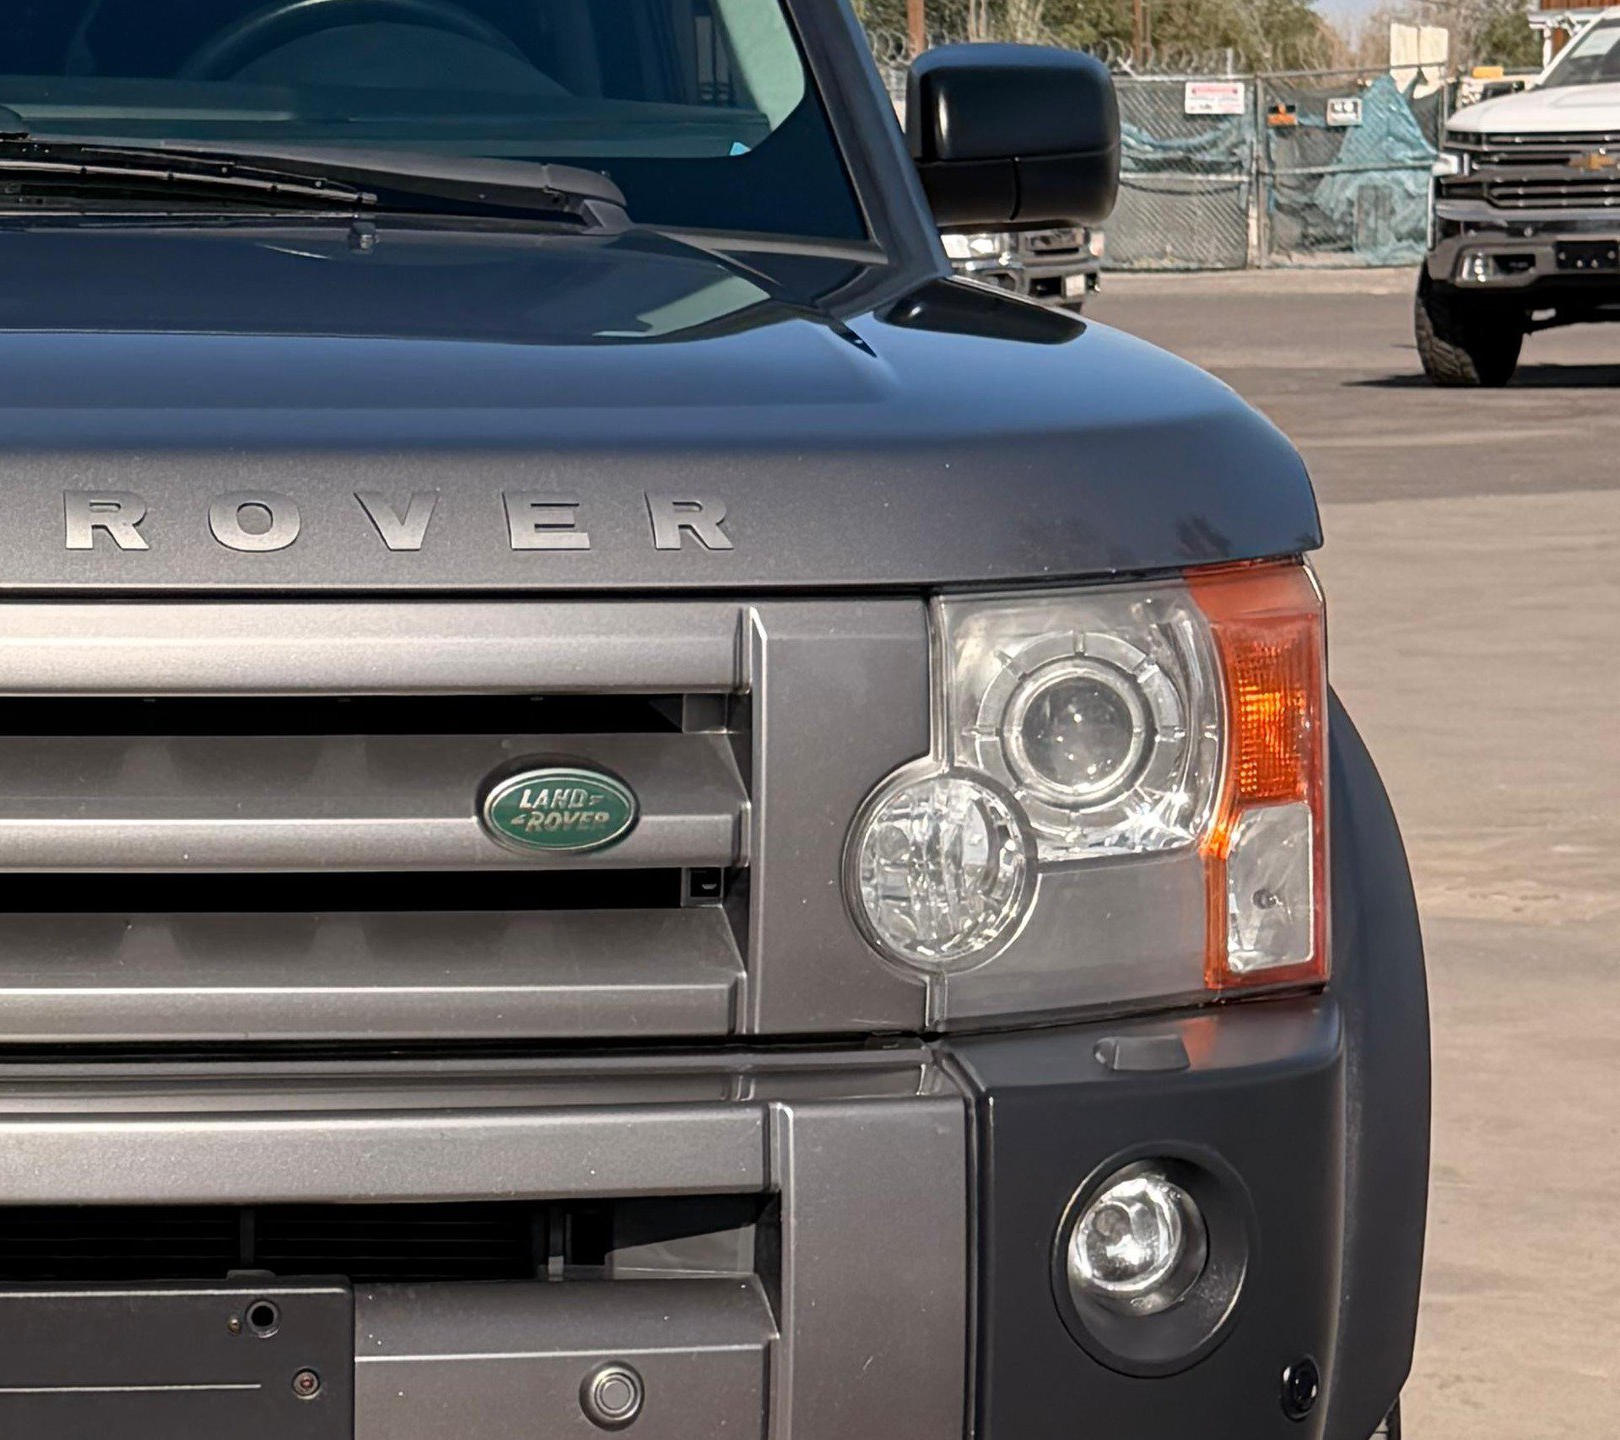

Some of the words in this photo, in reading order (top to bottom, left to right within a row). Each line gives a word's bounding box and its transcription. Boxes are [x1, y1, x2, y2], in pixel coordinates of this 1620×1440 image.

[62, 489, 735, 551] ROVER
[519, 788, 589, 809] LAND
[525, 810, 611, 833] ROVER
